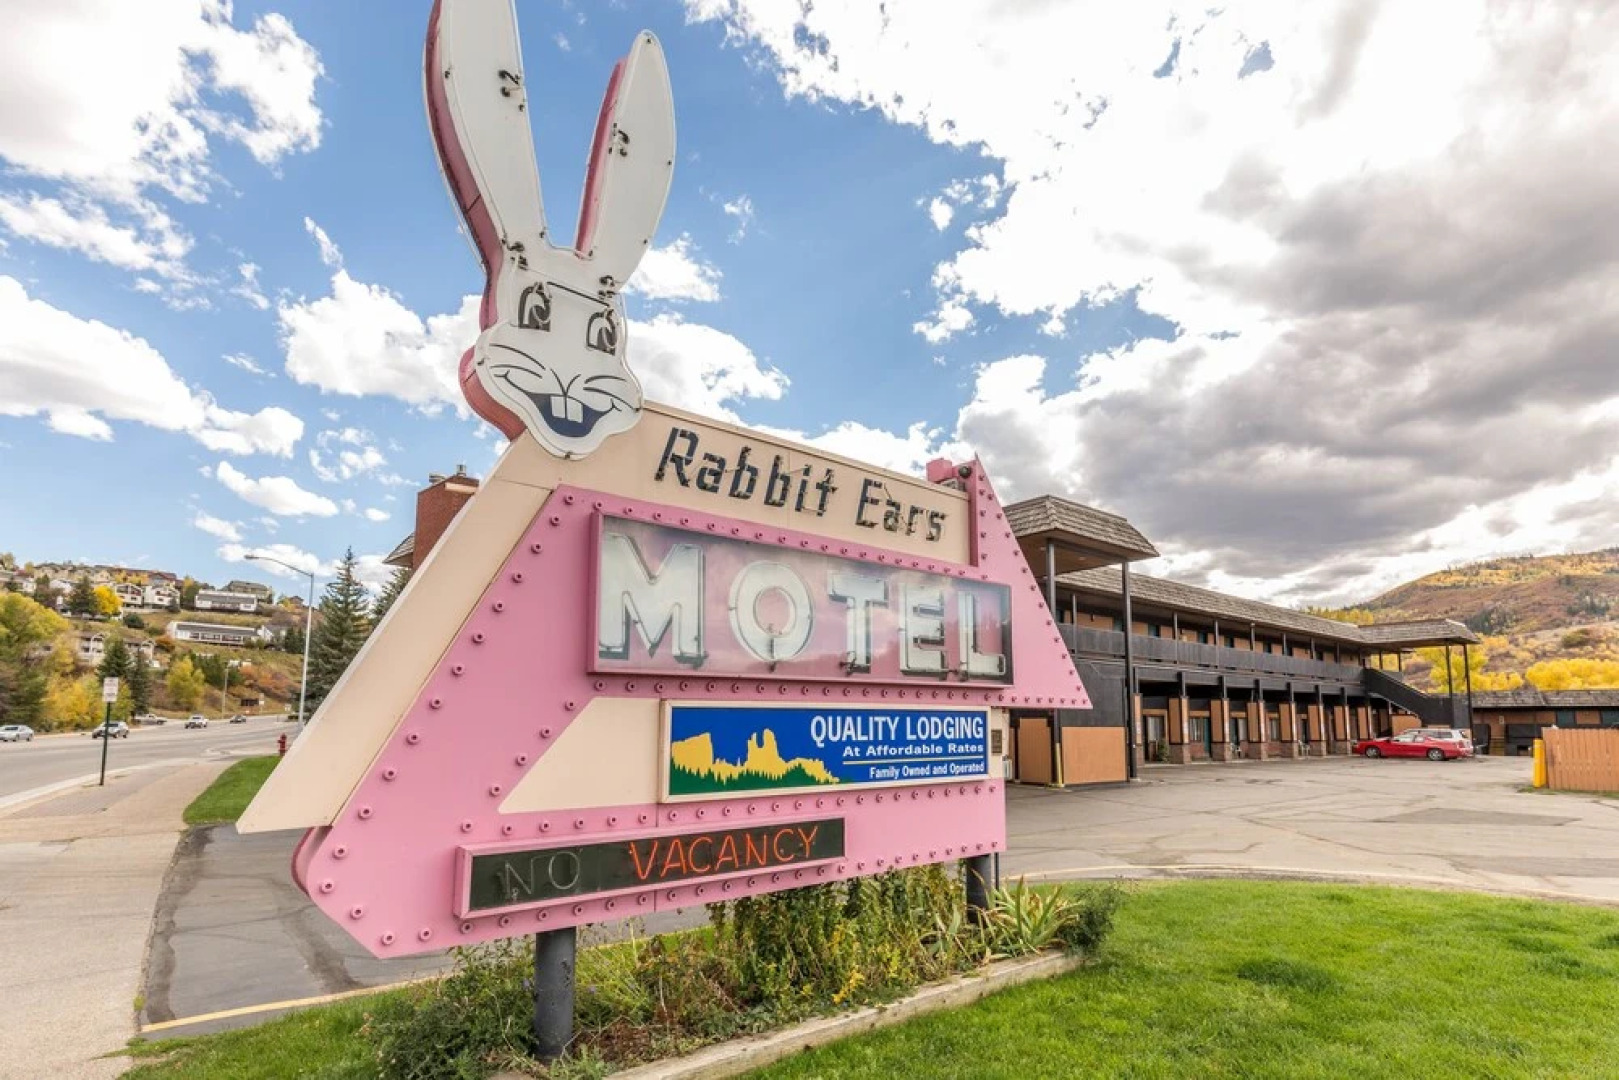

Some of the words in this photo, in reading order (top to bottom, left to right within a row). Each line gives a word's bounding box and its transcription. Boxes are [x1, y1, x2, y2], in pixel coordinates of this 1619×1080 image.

[654, 426, 838, 517] Rabbit
[855, 477, 947, 542] Ears
[599, 532, 1007, 682] MOTEL
[810, 715, 900, 748] QUALITY
[906, 716, 984, 740] LODGING
[842, 745, 861, 757] At
[865, 743, 943, 757] Affordable
[948, 742, 984, 753] Rates
[869, 766, 900, 780] Family
[902, 764, 930, 777] Owned
[932, 763, 948, 775] and
[949, 761, 985, 774] Operated
[503, 851, 582, 896] NO
[628, 825, 819, 880] VACANCY
